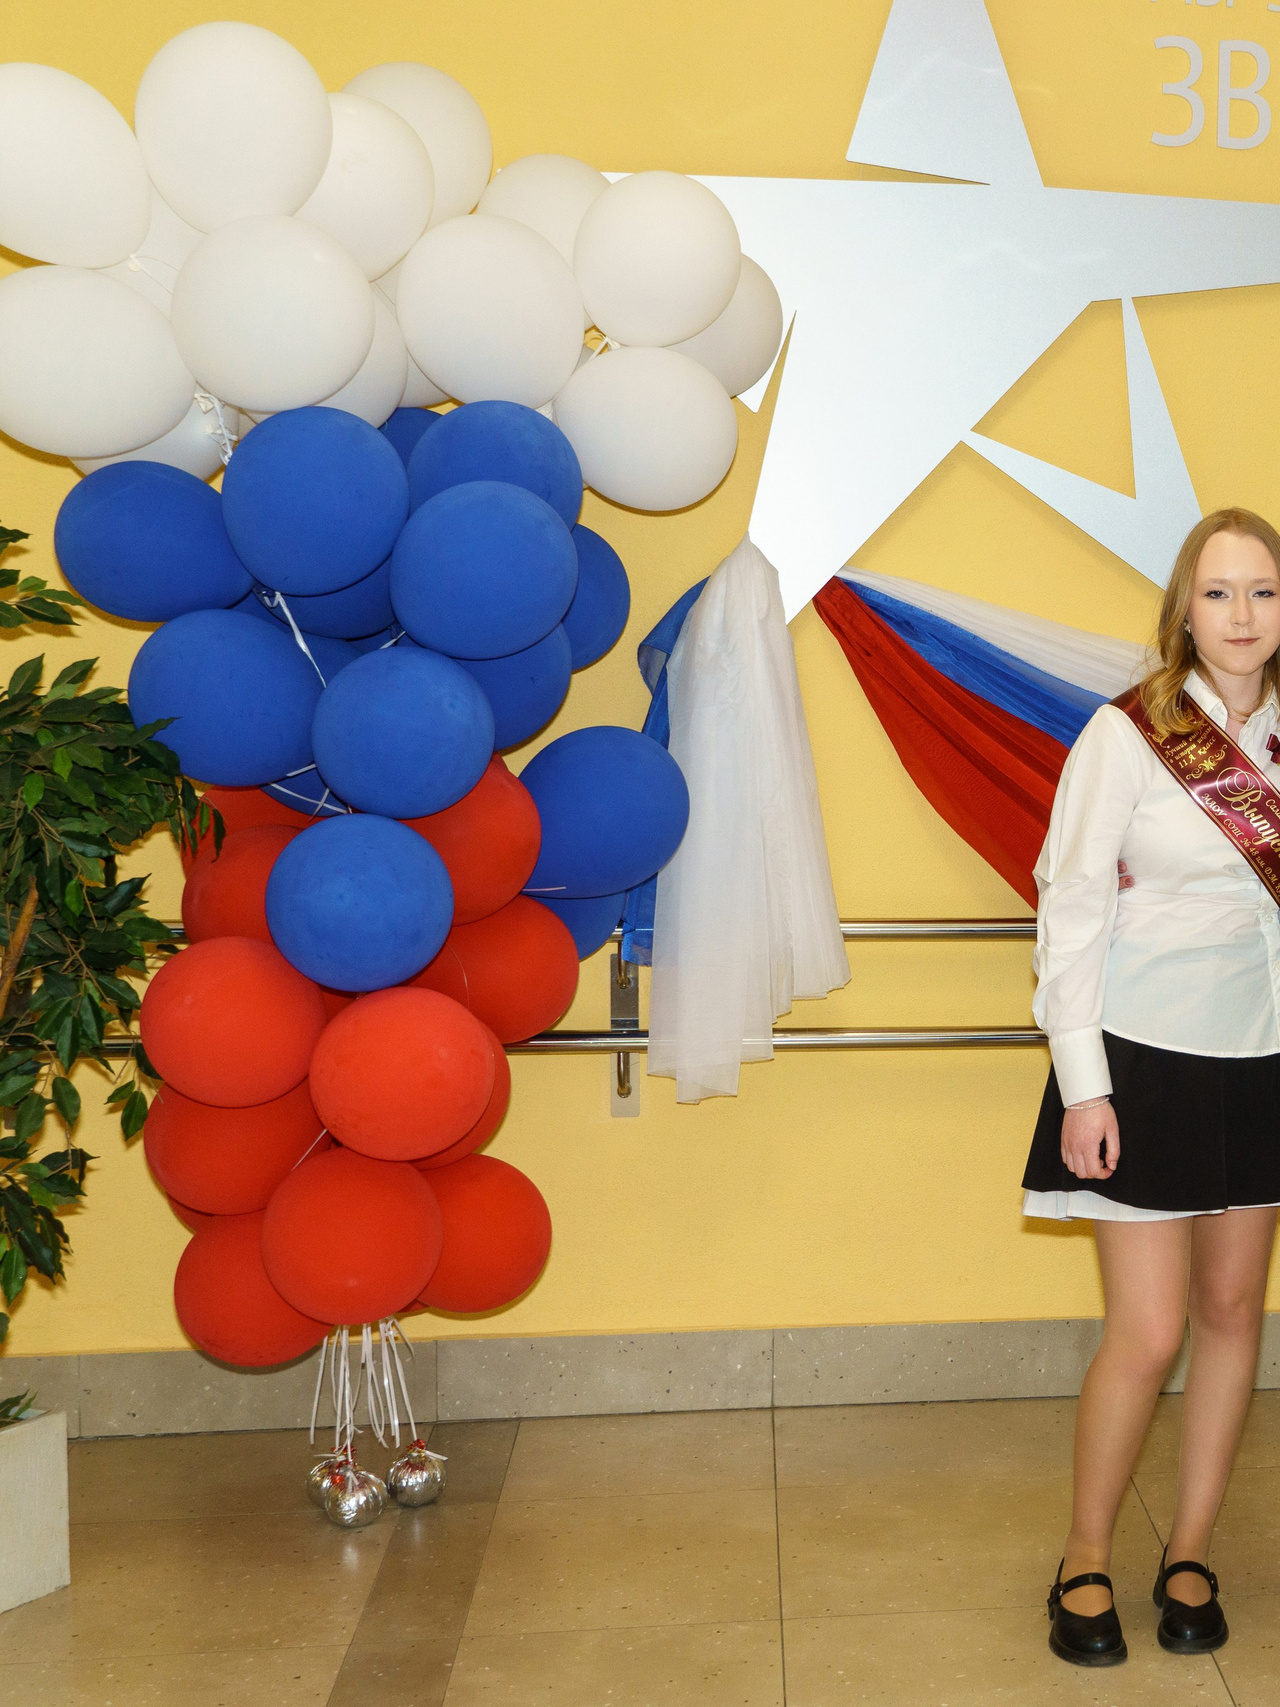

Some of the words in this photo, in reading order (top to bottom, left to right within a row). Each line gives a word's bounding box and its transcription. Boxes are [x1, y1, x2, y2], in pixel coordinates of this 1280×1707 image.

[1164, 740, 1188, 758] Лучший
[1174, 743, 1197, 762] истории
[1178, 759, 1188, 769] 11
[1201, 793, 1228, 816] МАОУ
[1223, 818, 1244, 837] СОШ
[1249, 847, 1259, 856] 48
